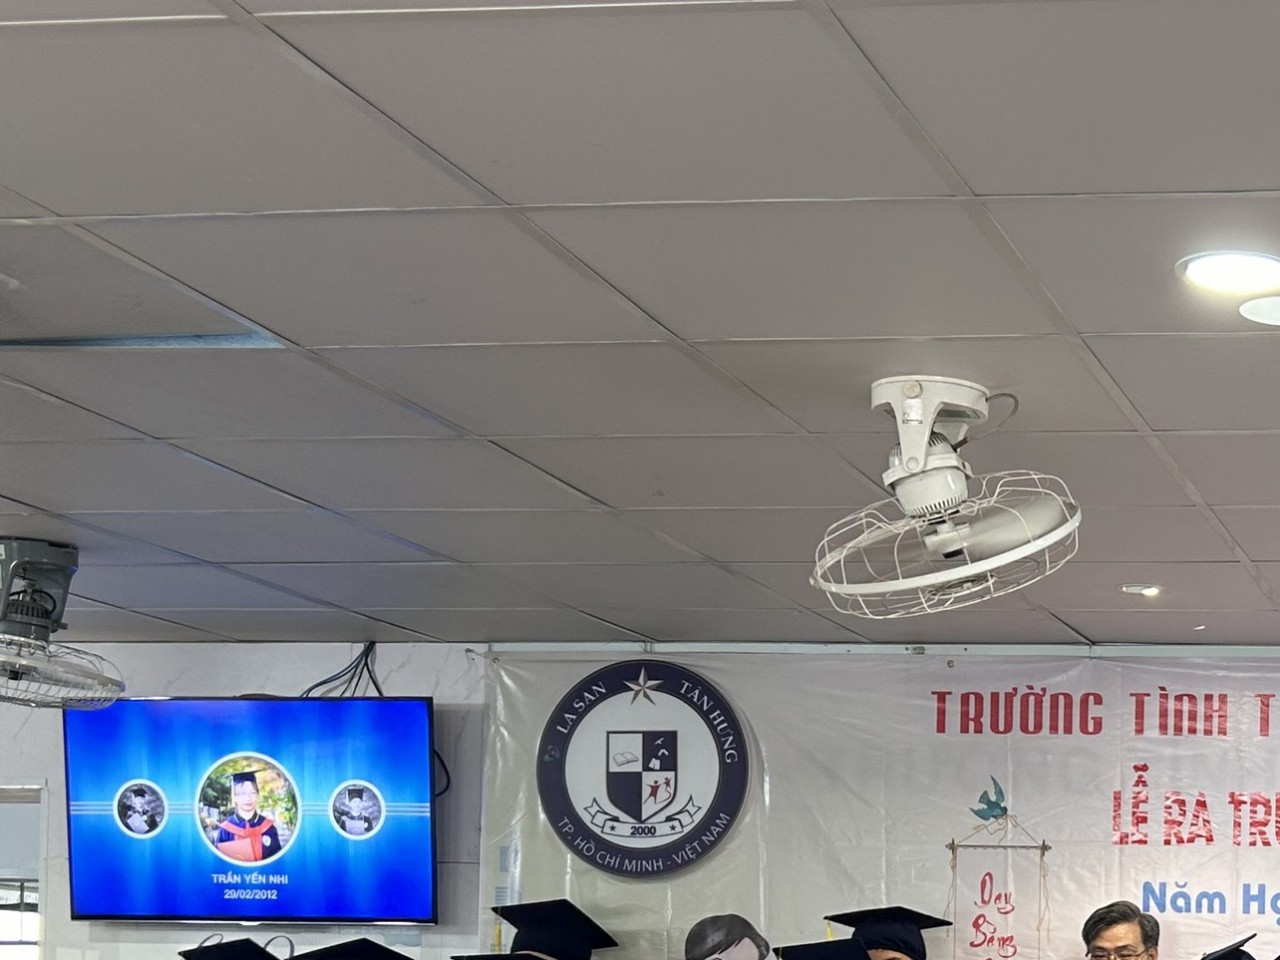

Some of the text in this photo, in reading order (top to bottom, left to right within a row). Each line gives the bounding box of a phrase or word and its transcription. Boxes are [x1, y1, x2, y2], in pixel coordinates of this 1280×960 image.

[556, 681, 607, 734] LA SAN
[679, 680, 739, 763] TÂN HƯNG
[931, 684, 1104, 736] TRƯỜNG
[1129, 686, 1228, 738] TÌNH
[630, 825, 657, 836] 2000
[1112, 762, 1149, 846] LỄ
[1163, 790, 1214, 847] RA
[573, 835, 596, 856] HỒ
[596, 850, 621, 869] CHÍ
[622, 858, 664, 873] MINH
[672, 840, 703, 865] VIỆT
[701, 812, 731, 846] NAM
[223, 888, 278, 900] 29/02/2012
[269, 874, 289, 884] NHI
[1141, 880, 1228, 915] Năm
